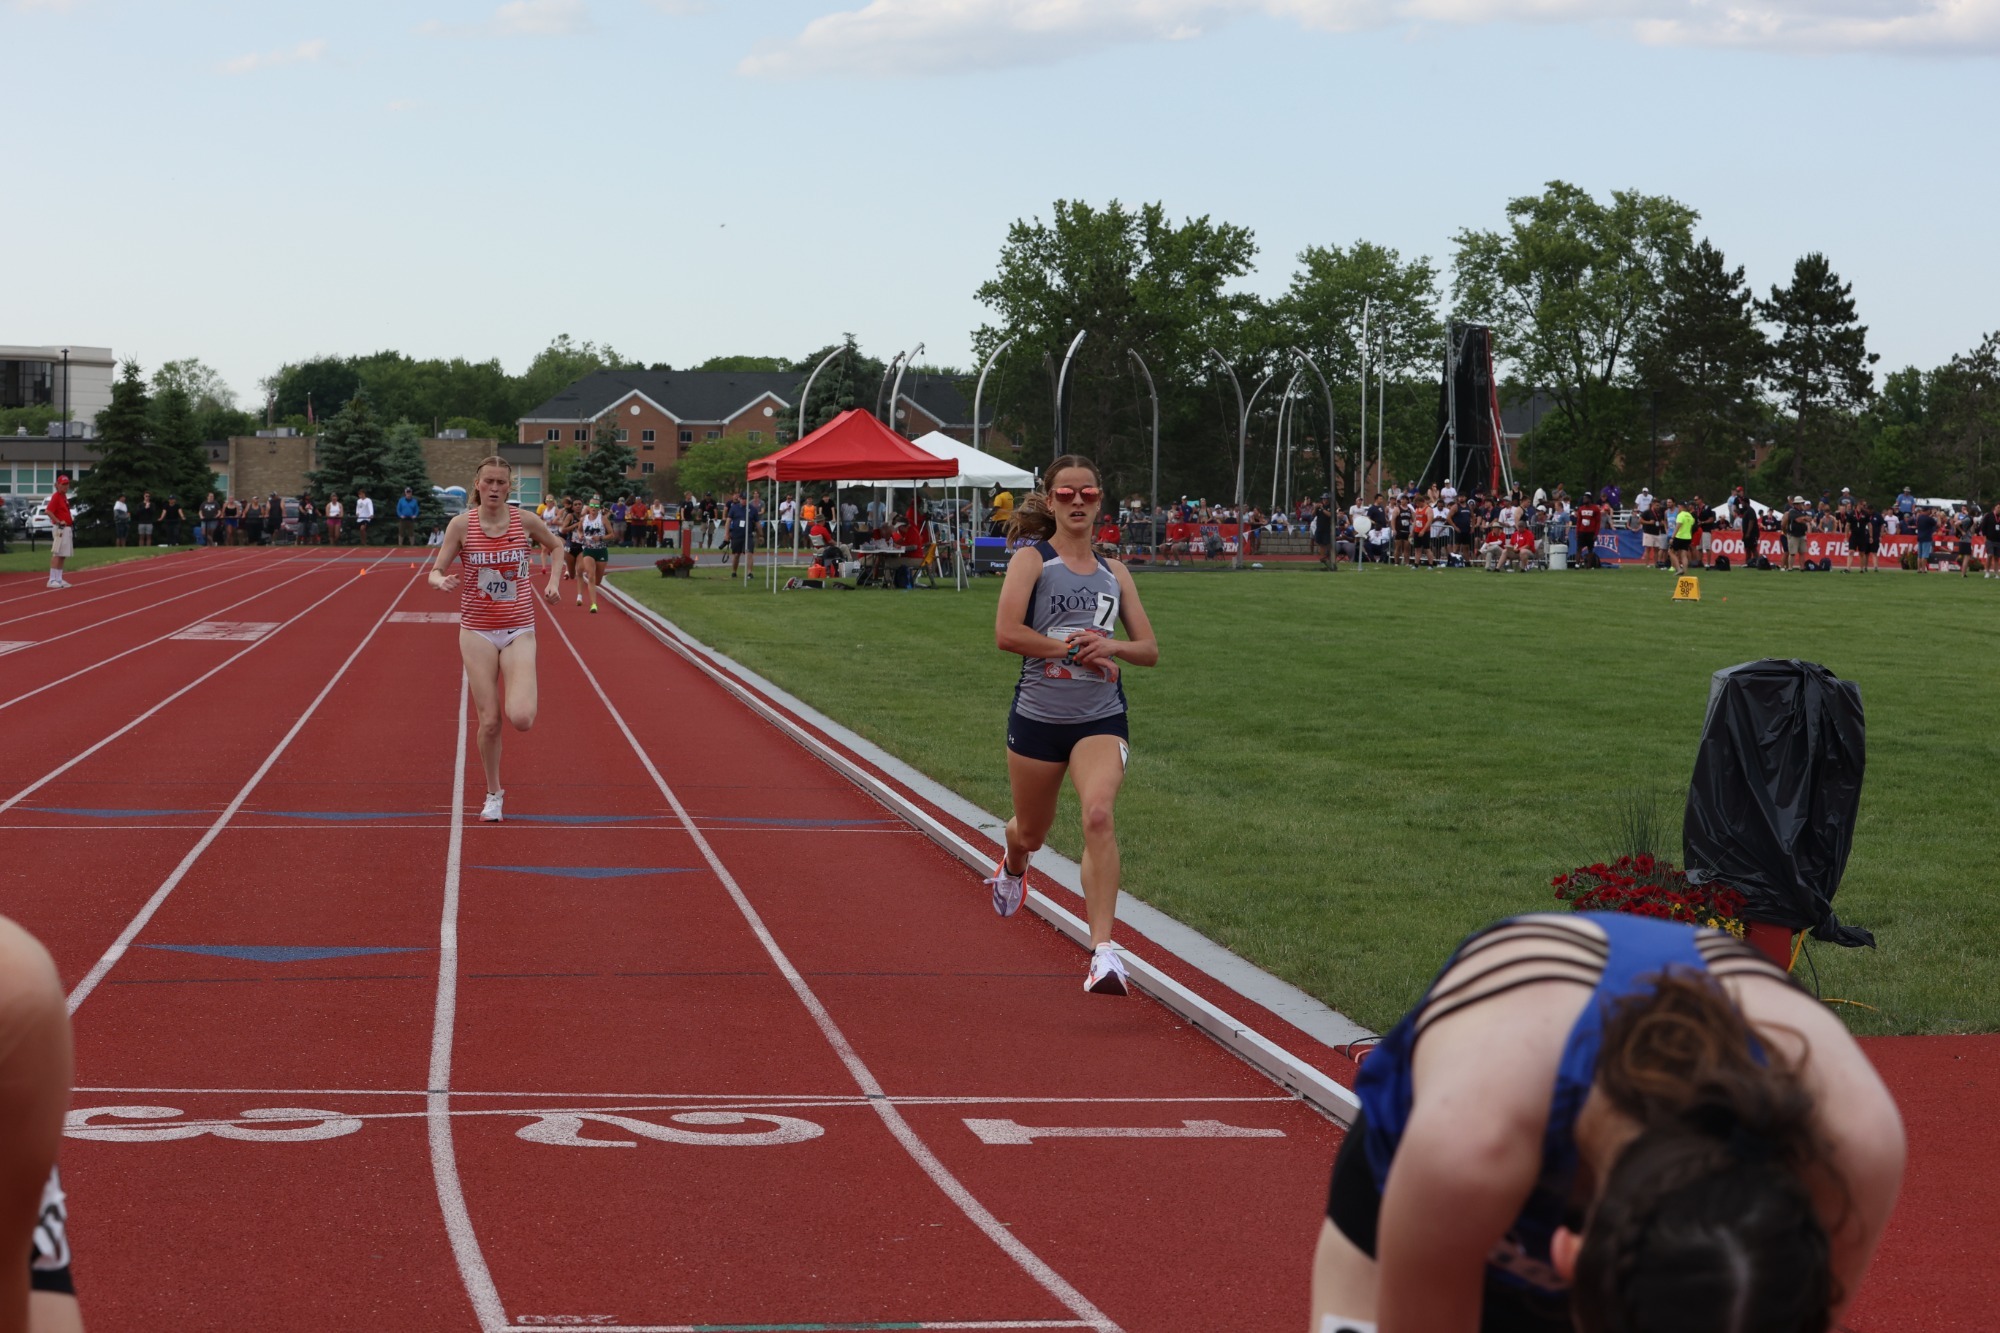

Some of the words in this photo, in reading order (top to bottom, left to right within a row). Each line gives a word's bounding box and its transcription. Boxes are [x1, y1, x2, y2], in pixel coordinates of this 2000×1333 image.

[1808, 541, 1820, 556] &
[469, 549, 525, 565] MILLIGAN
[486, 581, 507, 594] 479
[1679, 581, 1694, 589] 30m
[1050, 594, 1098, 615] ROYA
[1099, 595, 1115, 627] 7
[62, 1105, 363, 1142] 3
[515, 1110, 825, 1148] 2
[962, 1118, 1287, 1145] 1
